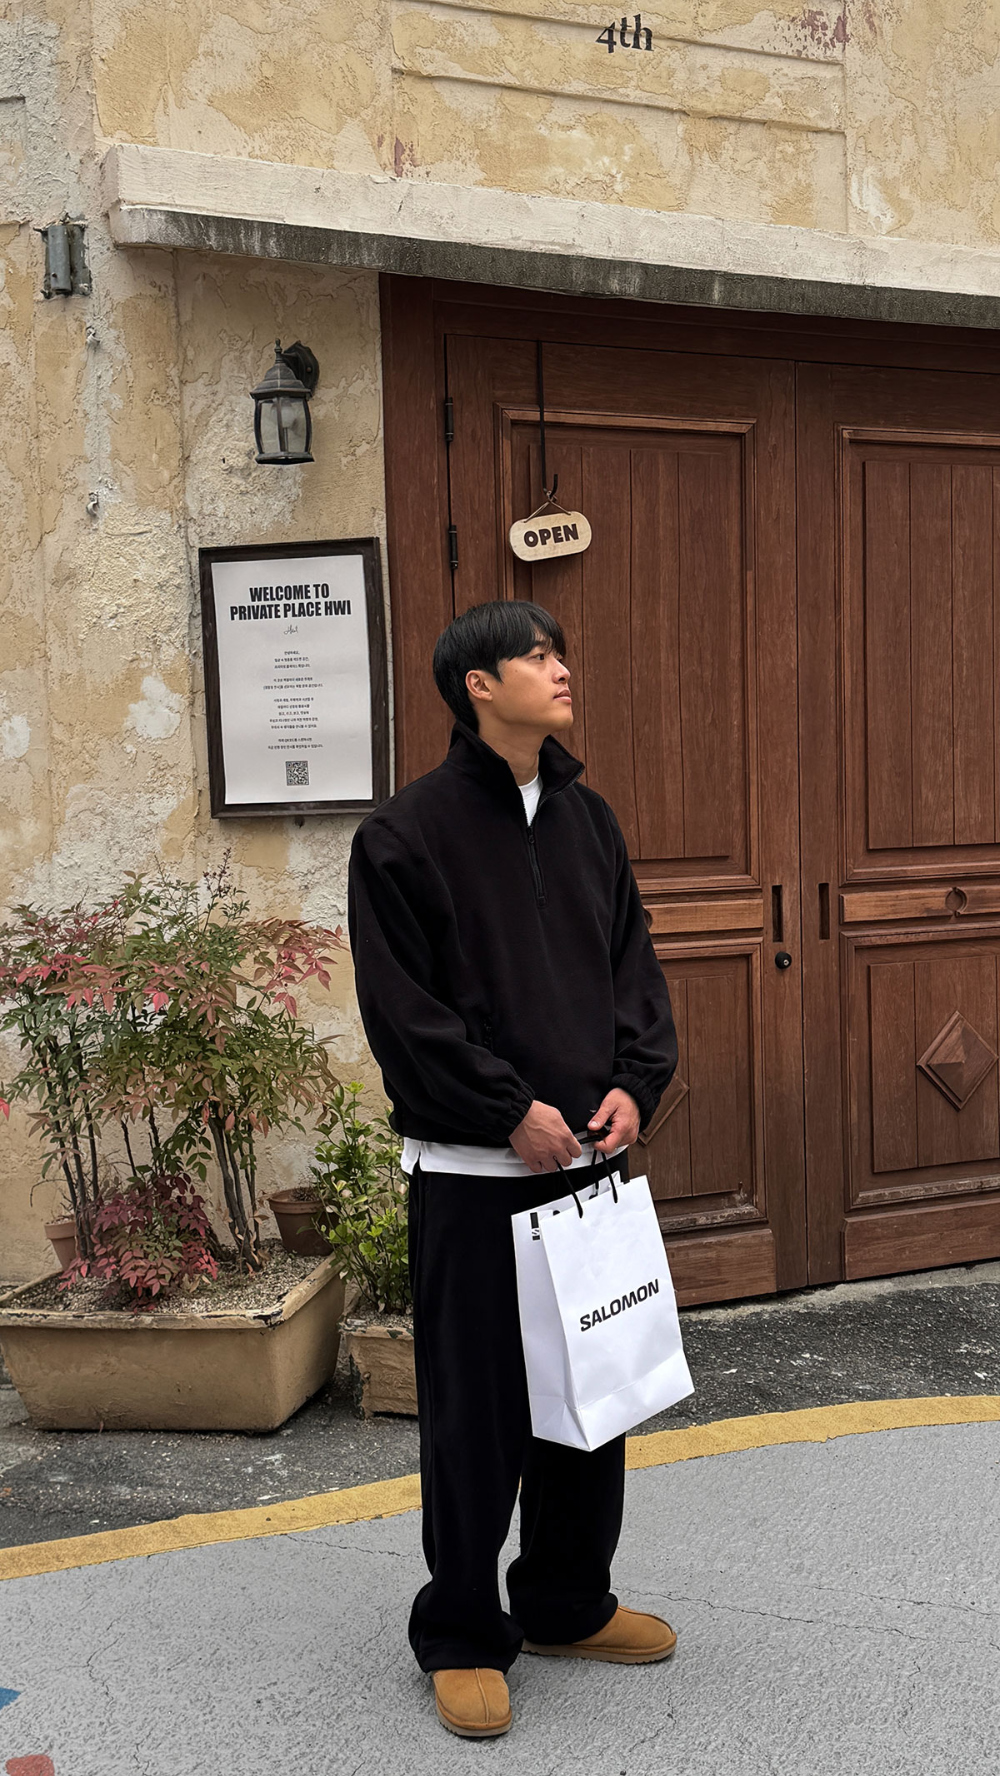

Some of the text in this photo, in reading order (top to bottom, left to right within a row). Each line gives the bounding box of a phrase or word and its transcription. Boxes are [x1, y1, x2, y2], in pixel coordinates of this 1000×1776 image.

[595, 14, 655, 54] 4th
[524, 523, 579, 548] OPEN
[249, 583, 330, 602] WELCOME TO
[230, 600, 352, 621] PRIVATE PLACE HWI
[580, 1278, 660, 1332] SALOMON
